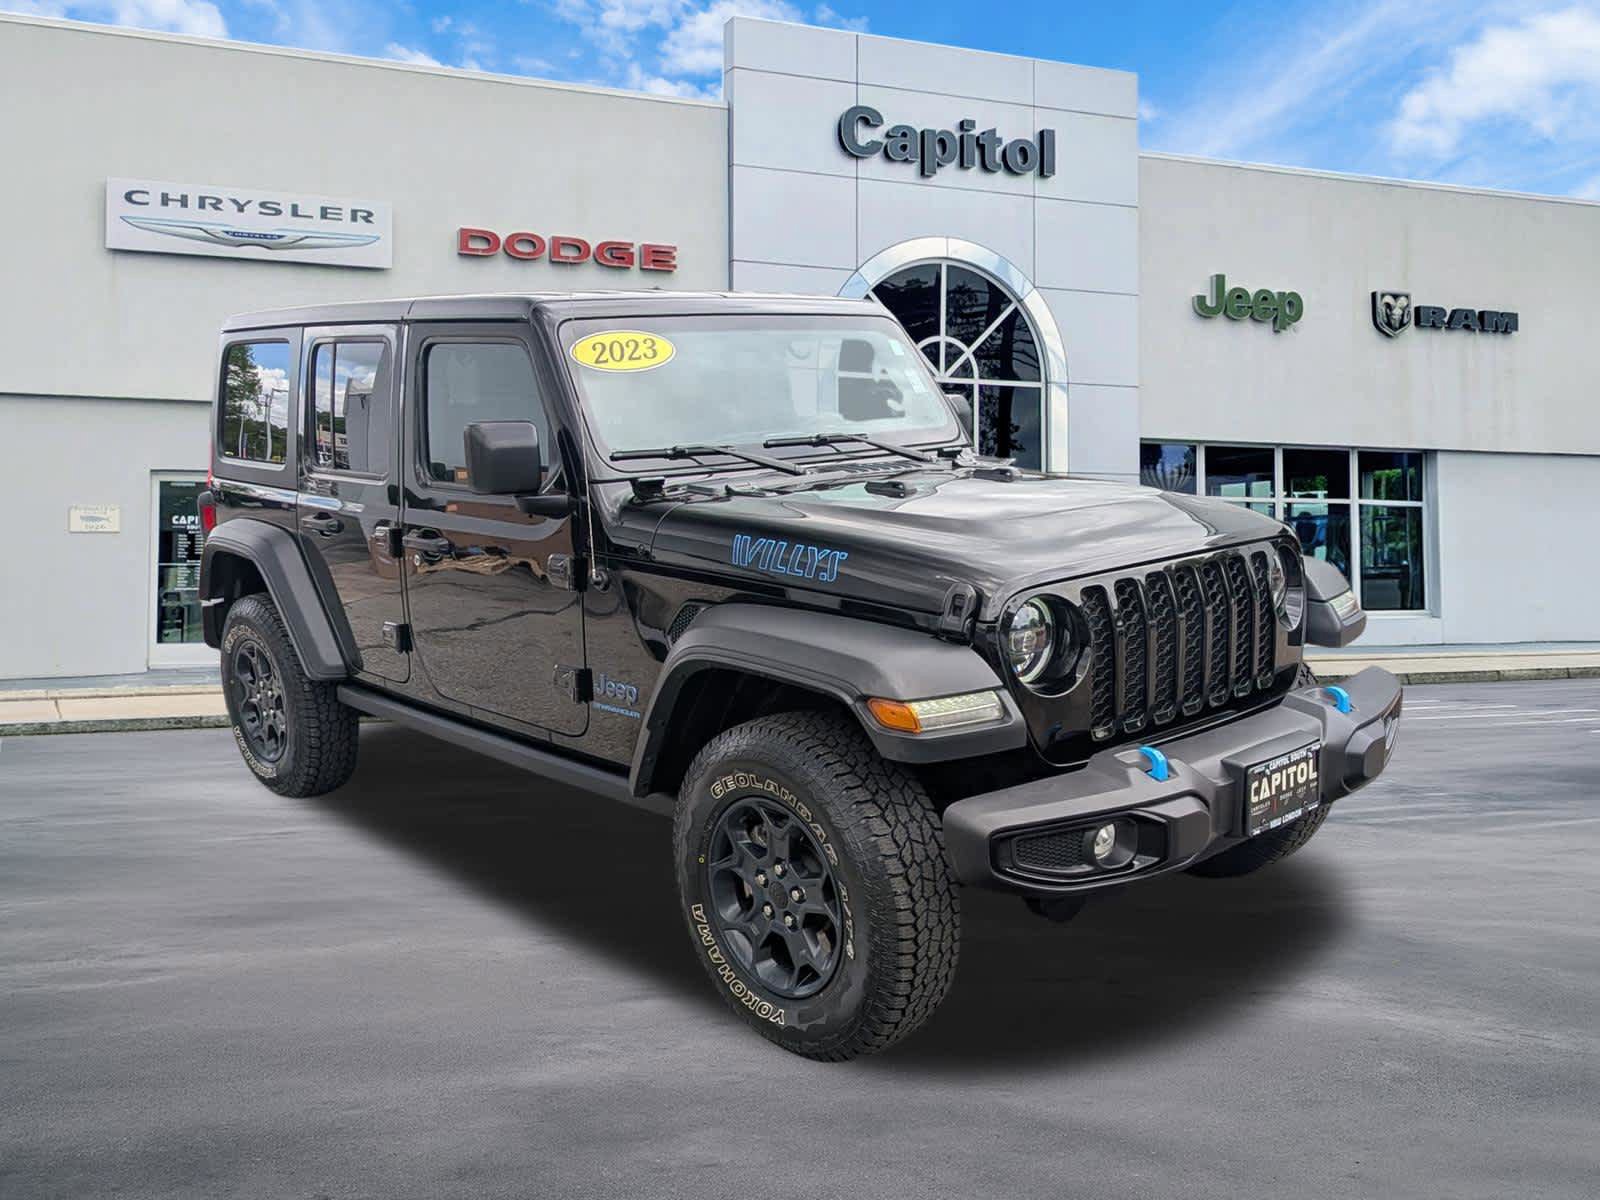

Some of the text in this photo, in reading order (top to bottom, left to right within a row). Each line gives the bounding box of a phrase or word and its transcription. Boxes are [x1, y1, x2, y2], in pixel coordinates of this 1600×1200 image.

[838, 105, 1055, 177] Capitol
[124, 189, 375, 224] CHRYSLER
[458, 227, 677, 272] DODGE
[1192, 273, 1304, 333] Jeep
[1415, 305, 1518, 334] RAM
[592, 338, 658, 364] 2023
[172, 515, 200, 525] CAPI
[732, 534, 848, 582] WILLYS
[594, 672, 638, 706] Jeep
[1251, 759, 1318, 803] CAPITOL
[691, 903, 786, 1025] YOKOHAMA
